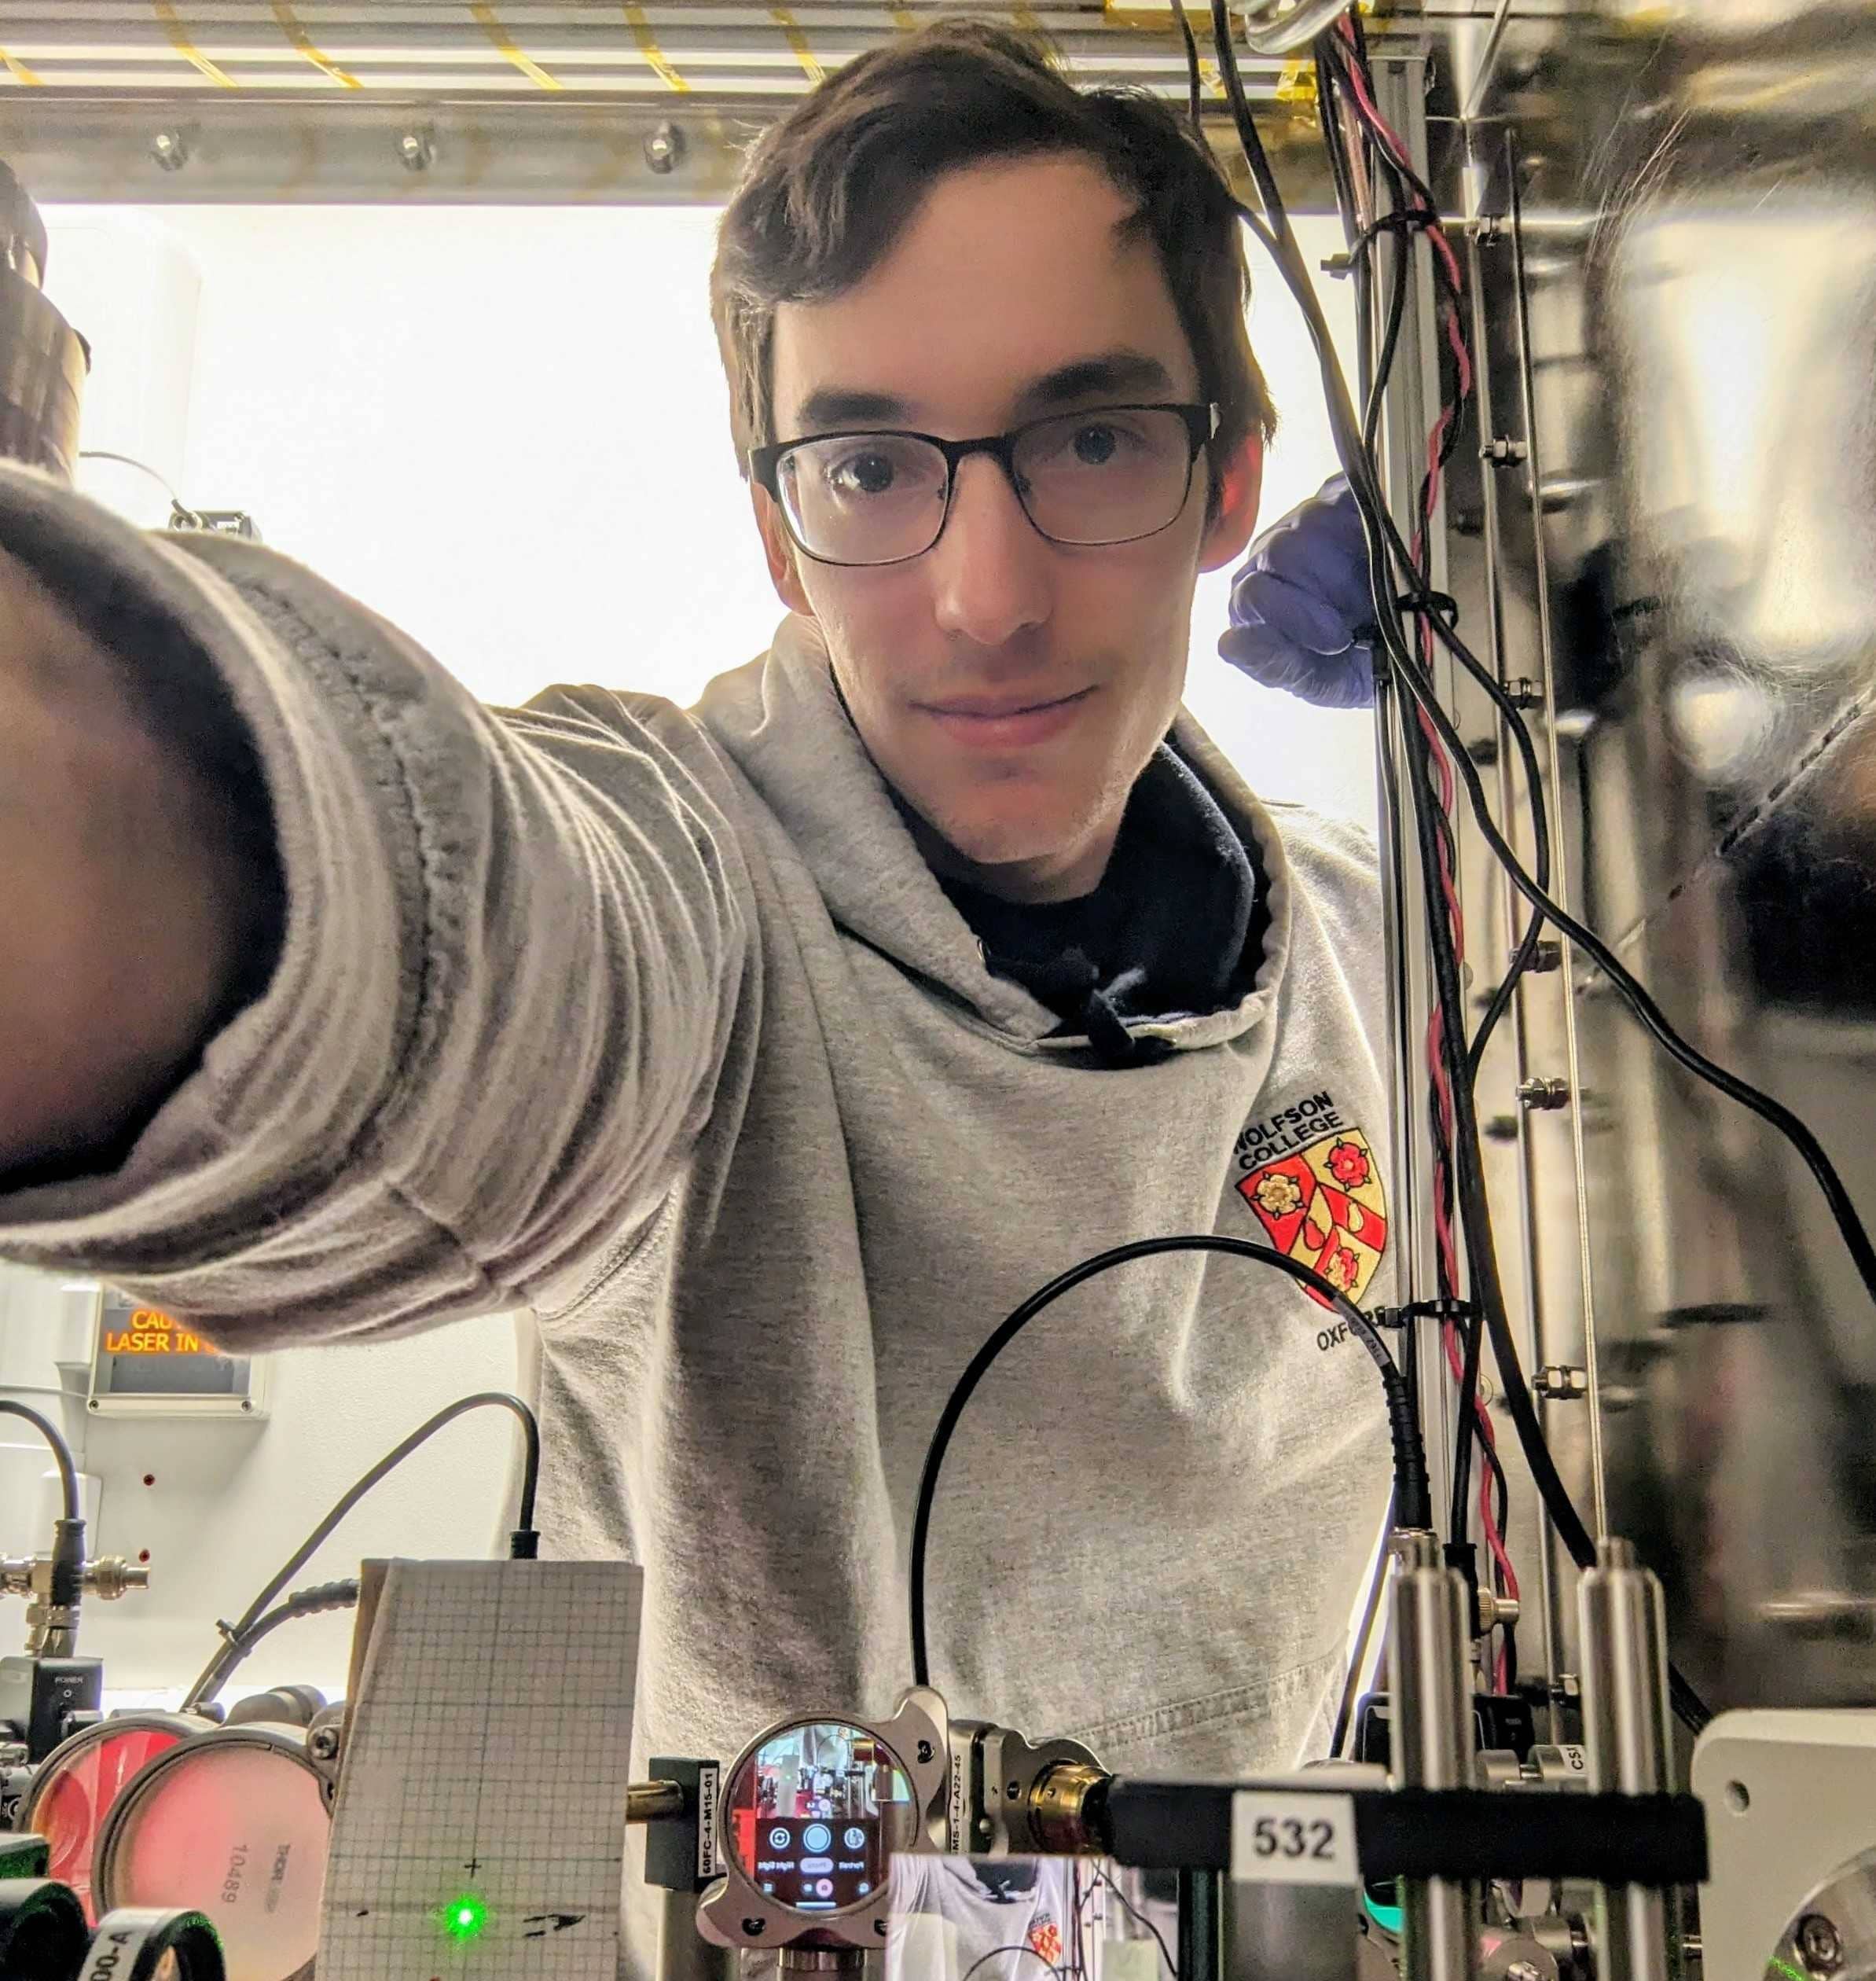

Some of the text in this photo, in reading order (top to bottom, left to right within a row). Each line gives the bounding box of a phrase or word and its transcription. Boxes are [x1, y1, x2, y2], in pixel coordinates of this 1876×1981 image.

[1234, 1091, 1334, 1155] WOLFSON
[1239, 1112, 1344, 1170] COLLEGE
[106, 1332, 171, 1352] LASER
[175, 1332, 199, 1352] IN
[703, 1773, 714, 1873] 60FC-4-M15-01
[1254, 1817, 1333, 1859] 532
[221, 1845, 248, 1903] 10489
